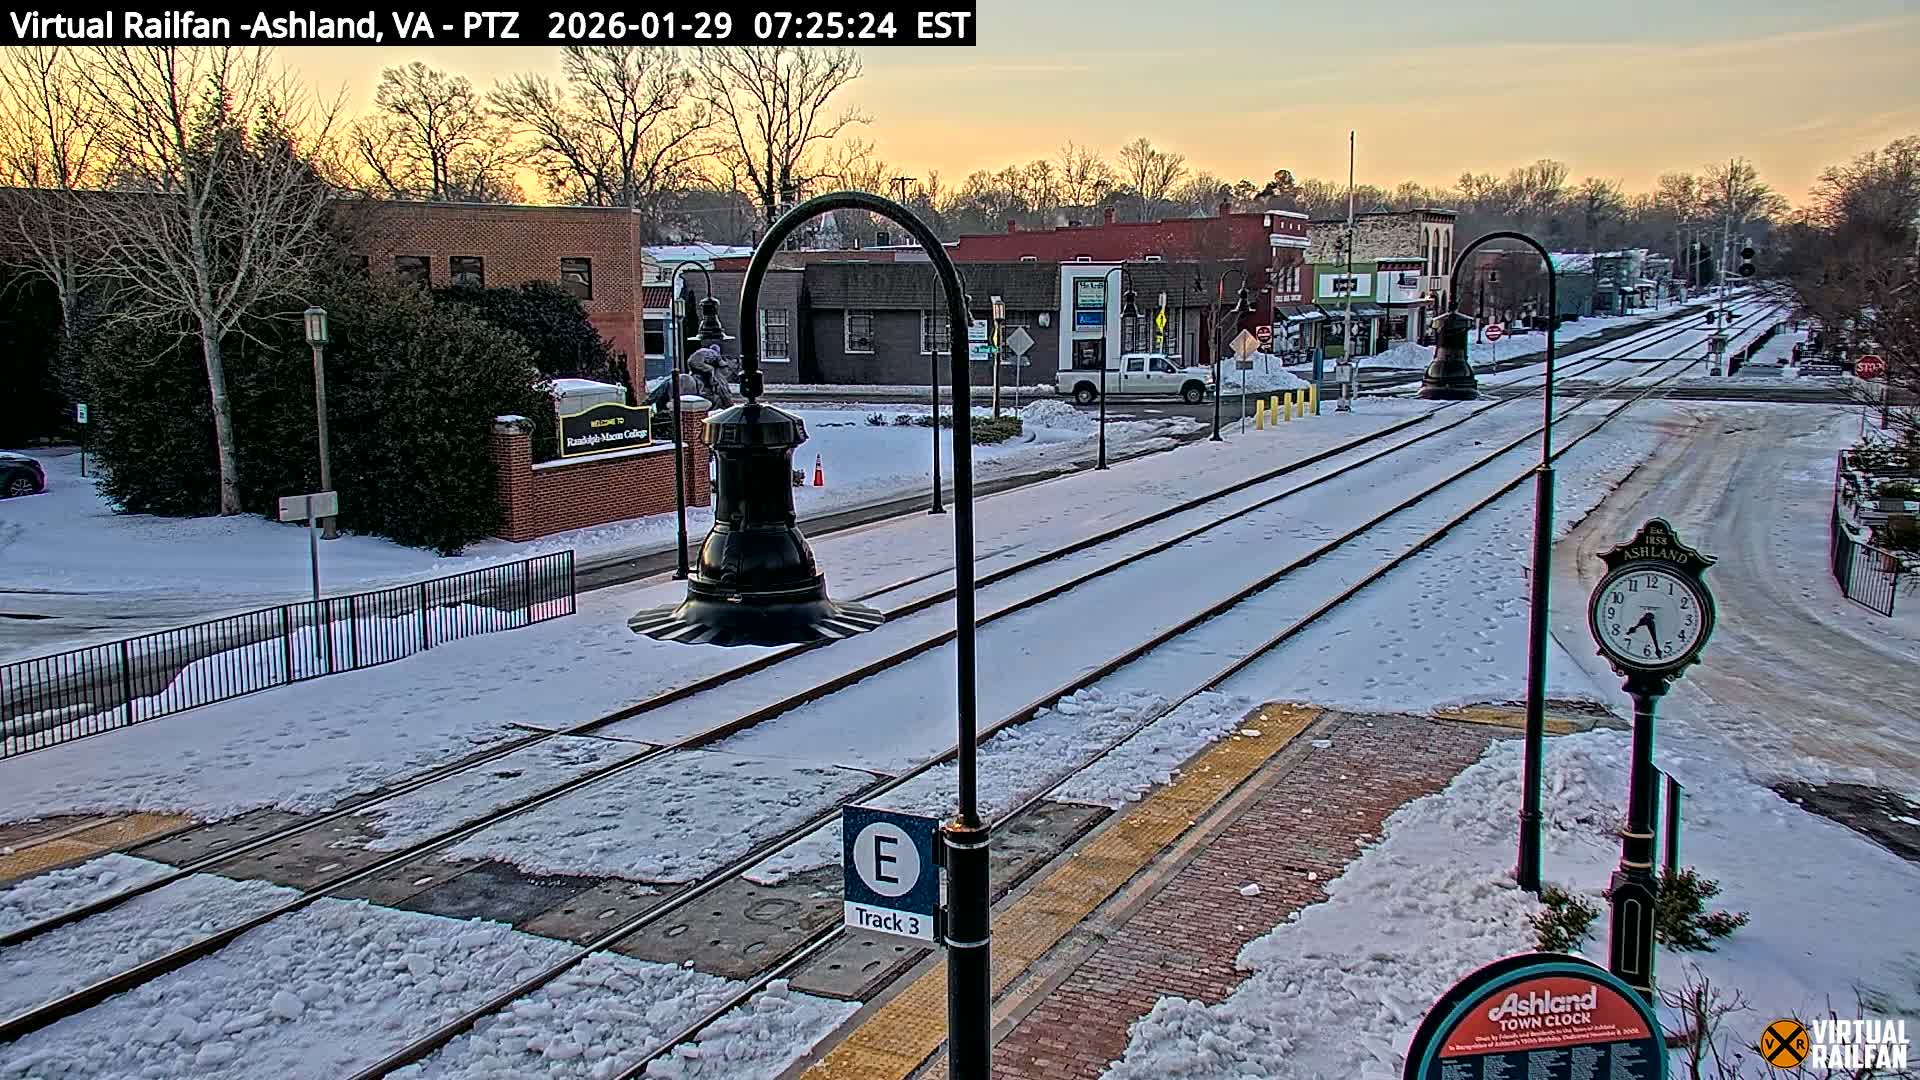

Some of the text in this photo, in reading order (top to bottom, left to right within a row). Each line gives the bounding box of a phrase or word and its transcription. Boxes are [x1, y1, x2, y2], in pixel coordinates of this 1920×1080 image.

[567, 429, 648, 447] Randolph-Macon College
[1646, 536, 1668, 545] 1858
[1624, 546, 1688, 564] ASHLAND
[1628, 579, 1638, 592] 11
[1646, 576, 1659, 589] 12
[1668, 583, 1674, 595] 1
[1611, 591, 1625, 604] 10
[1680, 596, 1689, 609] 2
[1607, 607, 1616, 620] 9
[1684, 614, 1694, 626] 3
[1611, 623, 1621, 636] 8
[1677, 629, 1687, 642] 4
[1623, 637, 1632, 651] 7
[1643, 644, 1652, 657] 6
[1663, 641, 1673, 656] 5
[874, 835, 899, 884] E
[855, 907, 920, 935] Track 3
[1488, 985, 1597, 1022] Ashland
[1499, 1012, 1591, 1031] TOWN CLOCK
